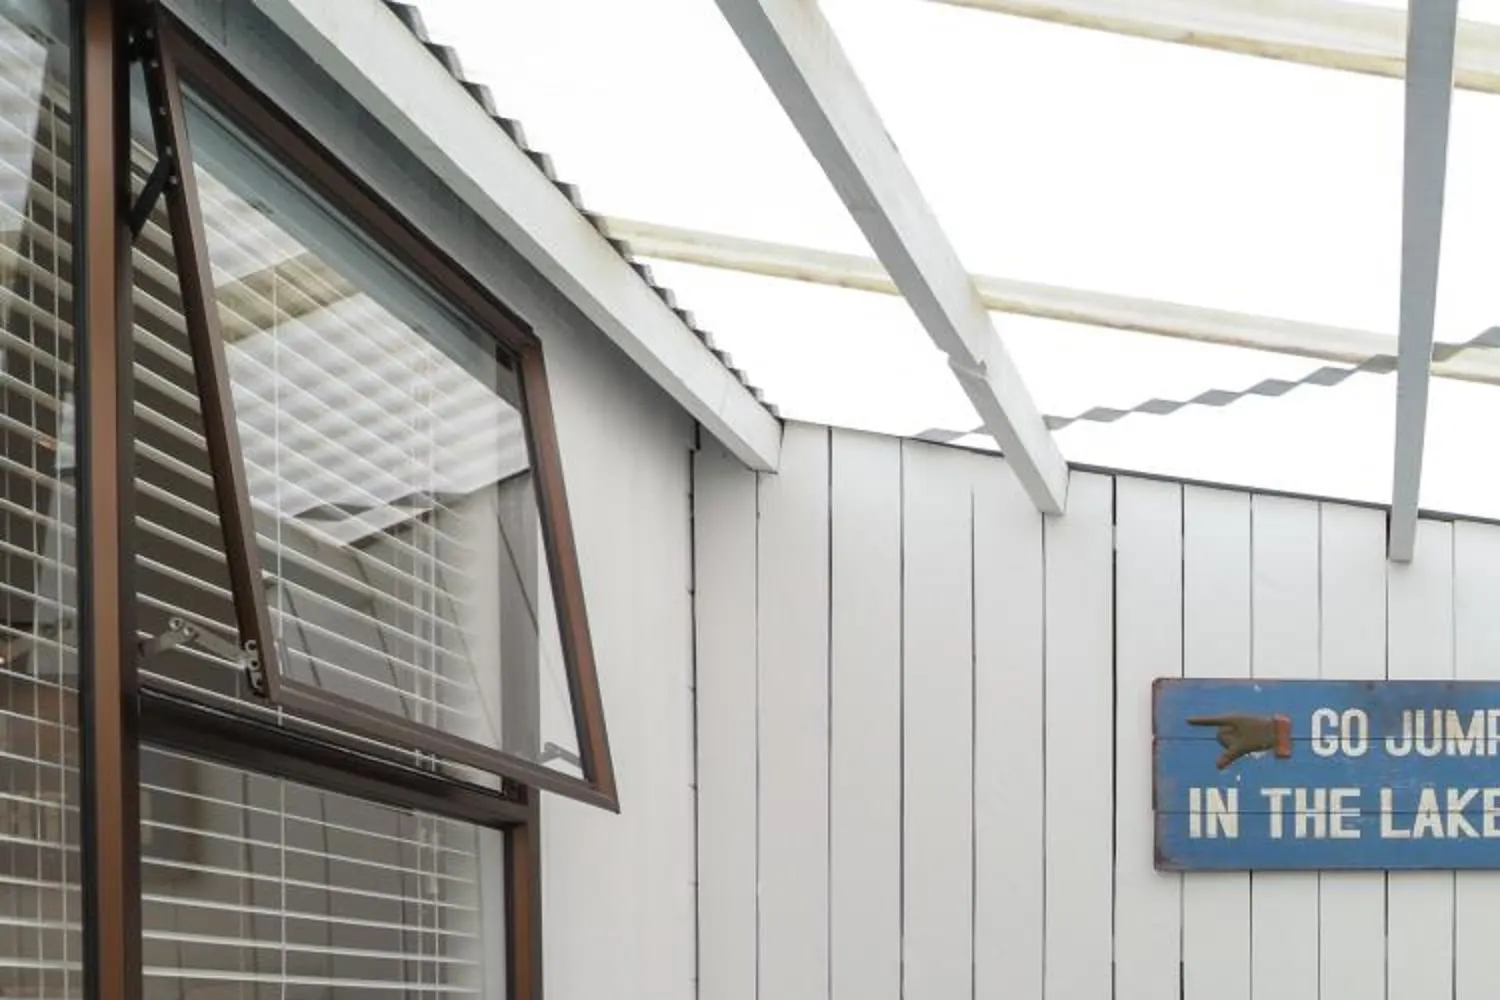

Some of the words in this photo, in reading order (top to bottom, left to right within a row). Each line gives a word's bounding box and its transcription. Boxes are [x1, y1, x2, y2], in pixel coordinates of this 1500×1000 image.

[1311, 707, 1368, 757] GO
[1188, 787, 1238, 838] IN
[1261, 787, 1361, 838] THE
